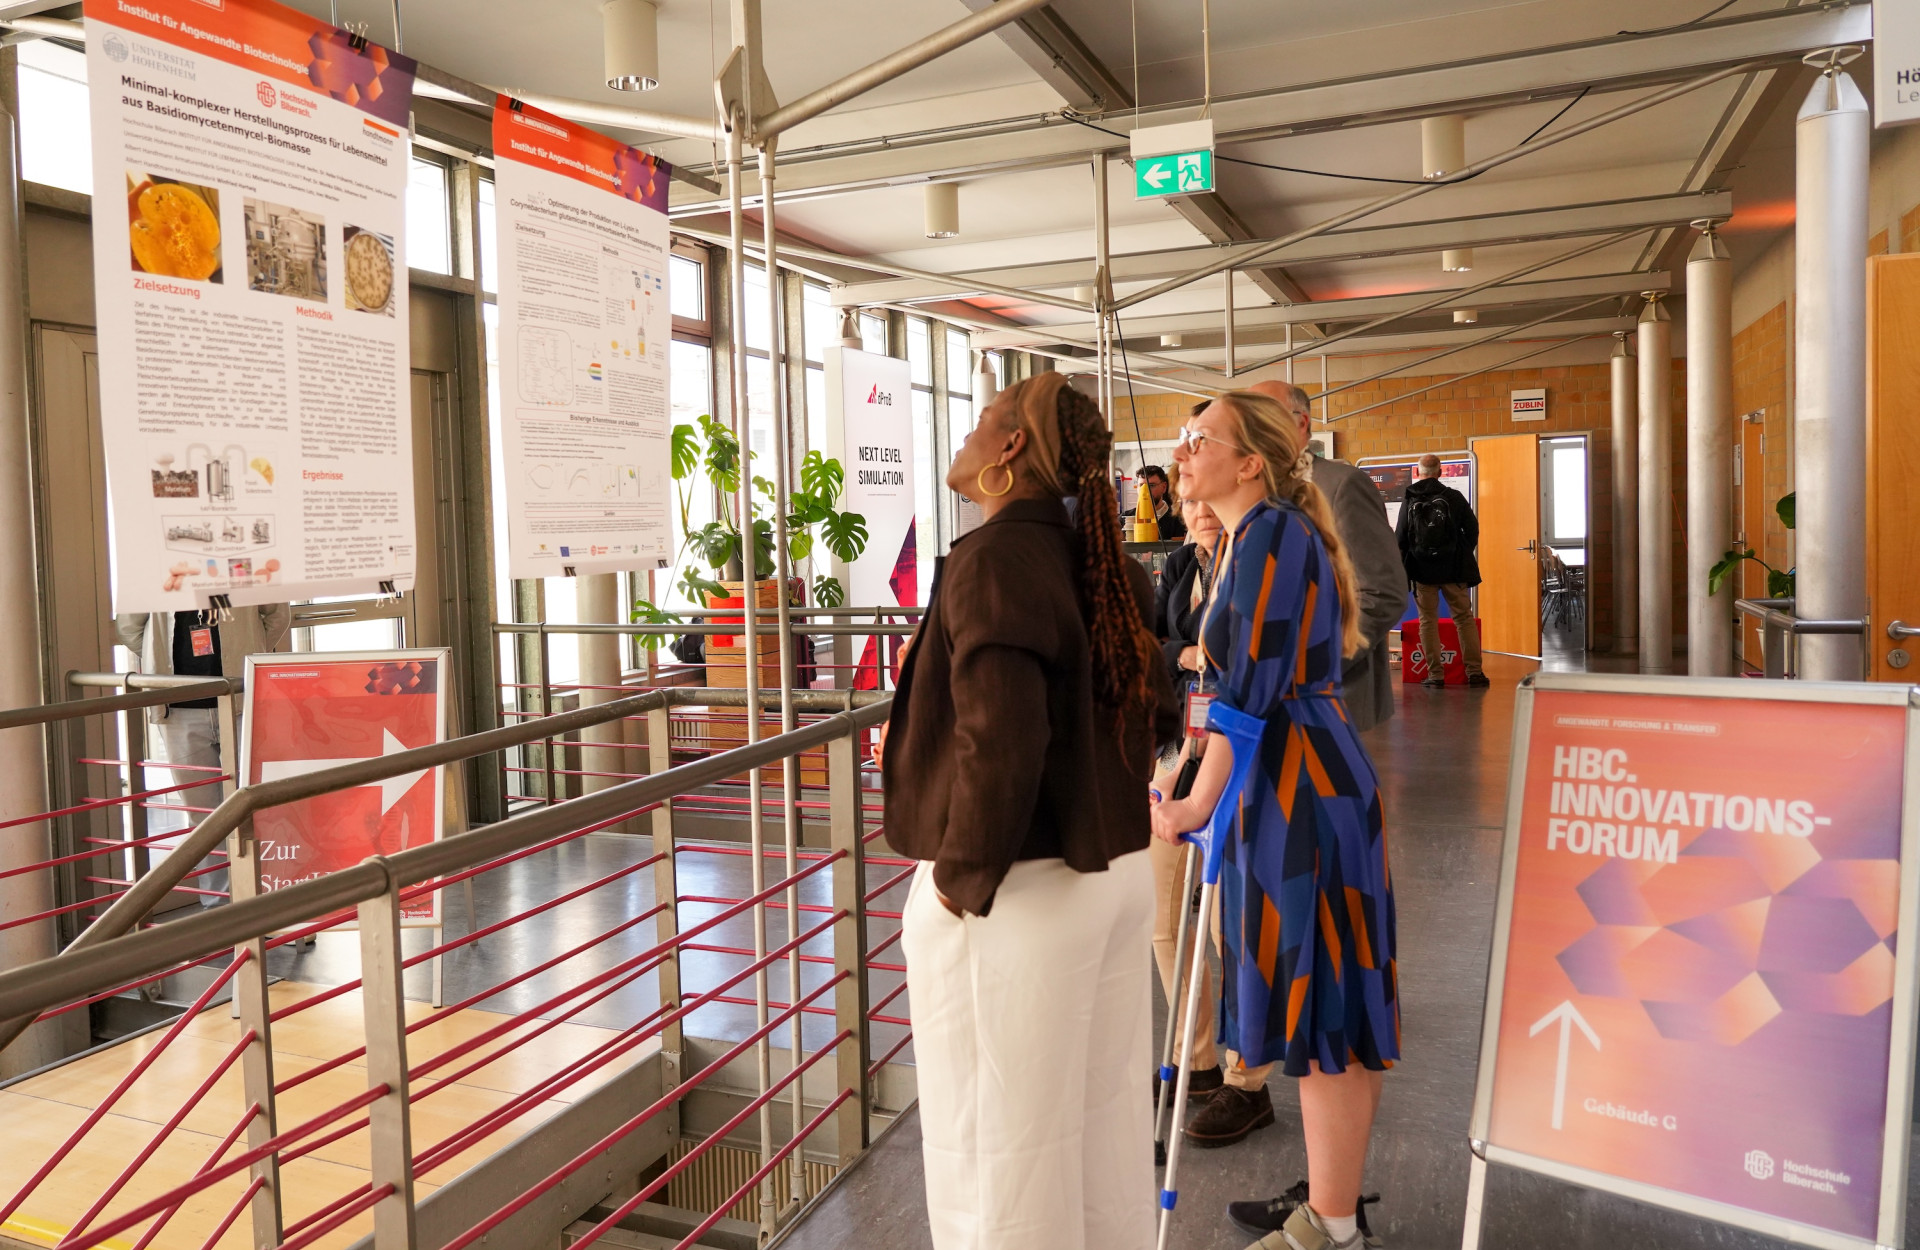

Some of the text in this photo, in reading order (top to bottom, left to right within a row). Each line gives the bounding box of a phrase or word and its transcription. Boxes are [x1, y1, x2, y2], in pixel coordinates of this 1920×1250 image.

[117, 0, 309, 75] Institut für Angewandte Biotechnologie
[131, 42, 195, 69] UNIVERSITÄT
[132, 55, 196, 81] HOHENHEIM
[280, 90, 318, 110] Hochschule
[121, 75, 387, 166] Minimal-komplexer Herstellungsprozess für Lebensmittel
[122, 96, 311, 155] aus Basidiomycetenmycel-Biomasse
[510, 139, 622, 186] Institut für Angewandte Biotechnologie
[510, 199, 558, 218] Corynebacterium
[558, 212, 587, 226] glutamicum
[548, 199, 580, 215] Optimierung
[589, 211, 612, 224] Produktion
[515, 223, 546, 238] Zielsetzung
[134, 278, 200, 300] Zielsetzung
[296, 306, 333, 321] Methodik
[570, 414, 591, 423] Bisherige
[858, 446, 902, 463] NEXT LEVEL
[302, 470, 343, 481] Ergebnisse
[858, 470, 904, 485] SIMULATION
[1556, 717, 1610, 727] ANGEWANDTE
[1613, 719, 1661, 730] FORSCHUNG
[1672, 723, 1716, 733] TRANSFER
[1553, 745, 1637, 783] HBC.
[1550, 782, 1831, 837] INNOVATIONS-
[260, 840, 300, 861] Zur
[1547, 818, 1678, 864] FORUM
[1583, 1097, 1677, 1131] Gebäude G
[1783, 1159, 1851, 1185] Hochschule
[1783, 1172, 1837, 1194] Biberach.
